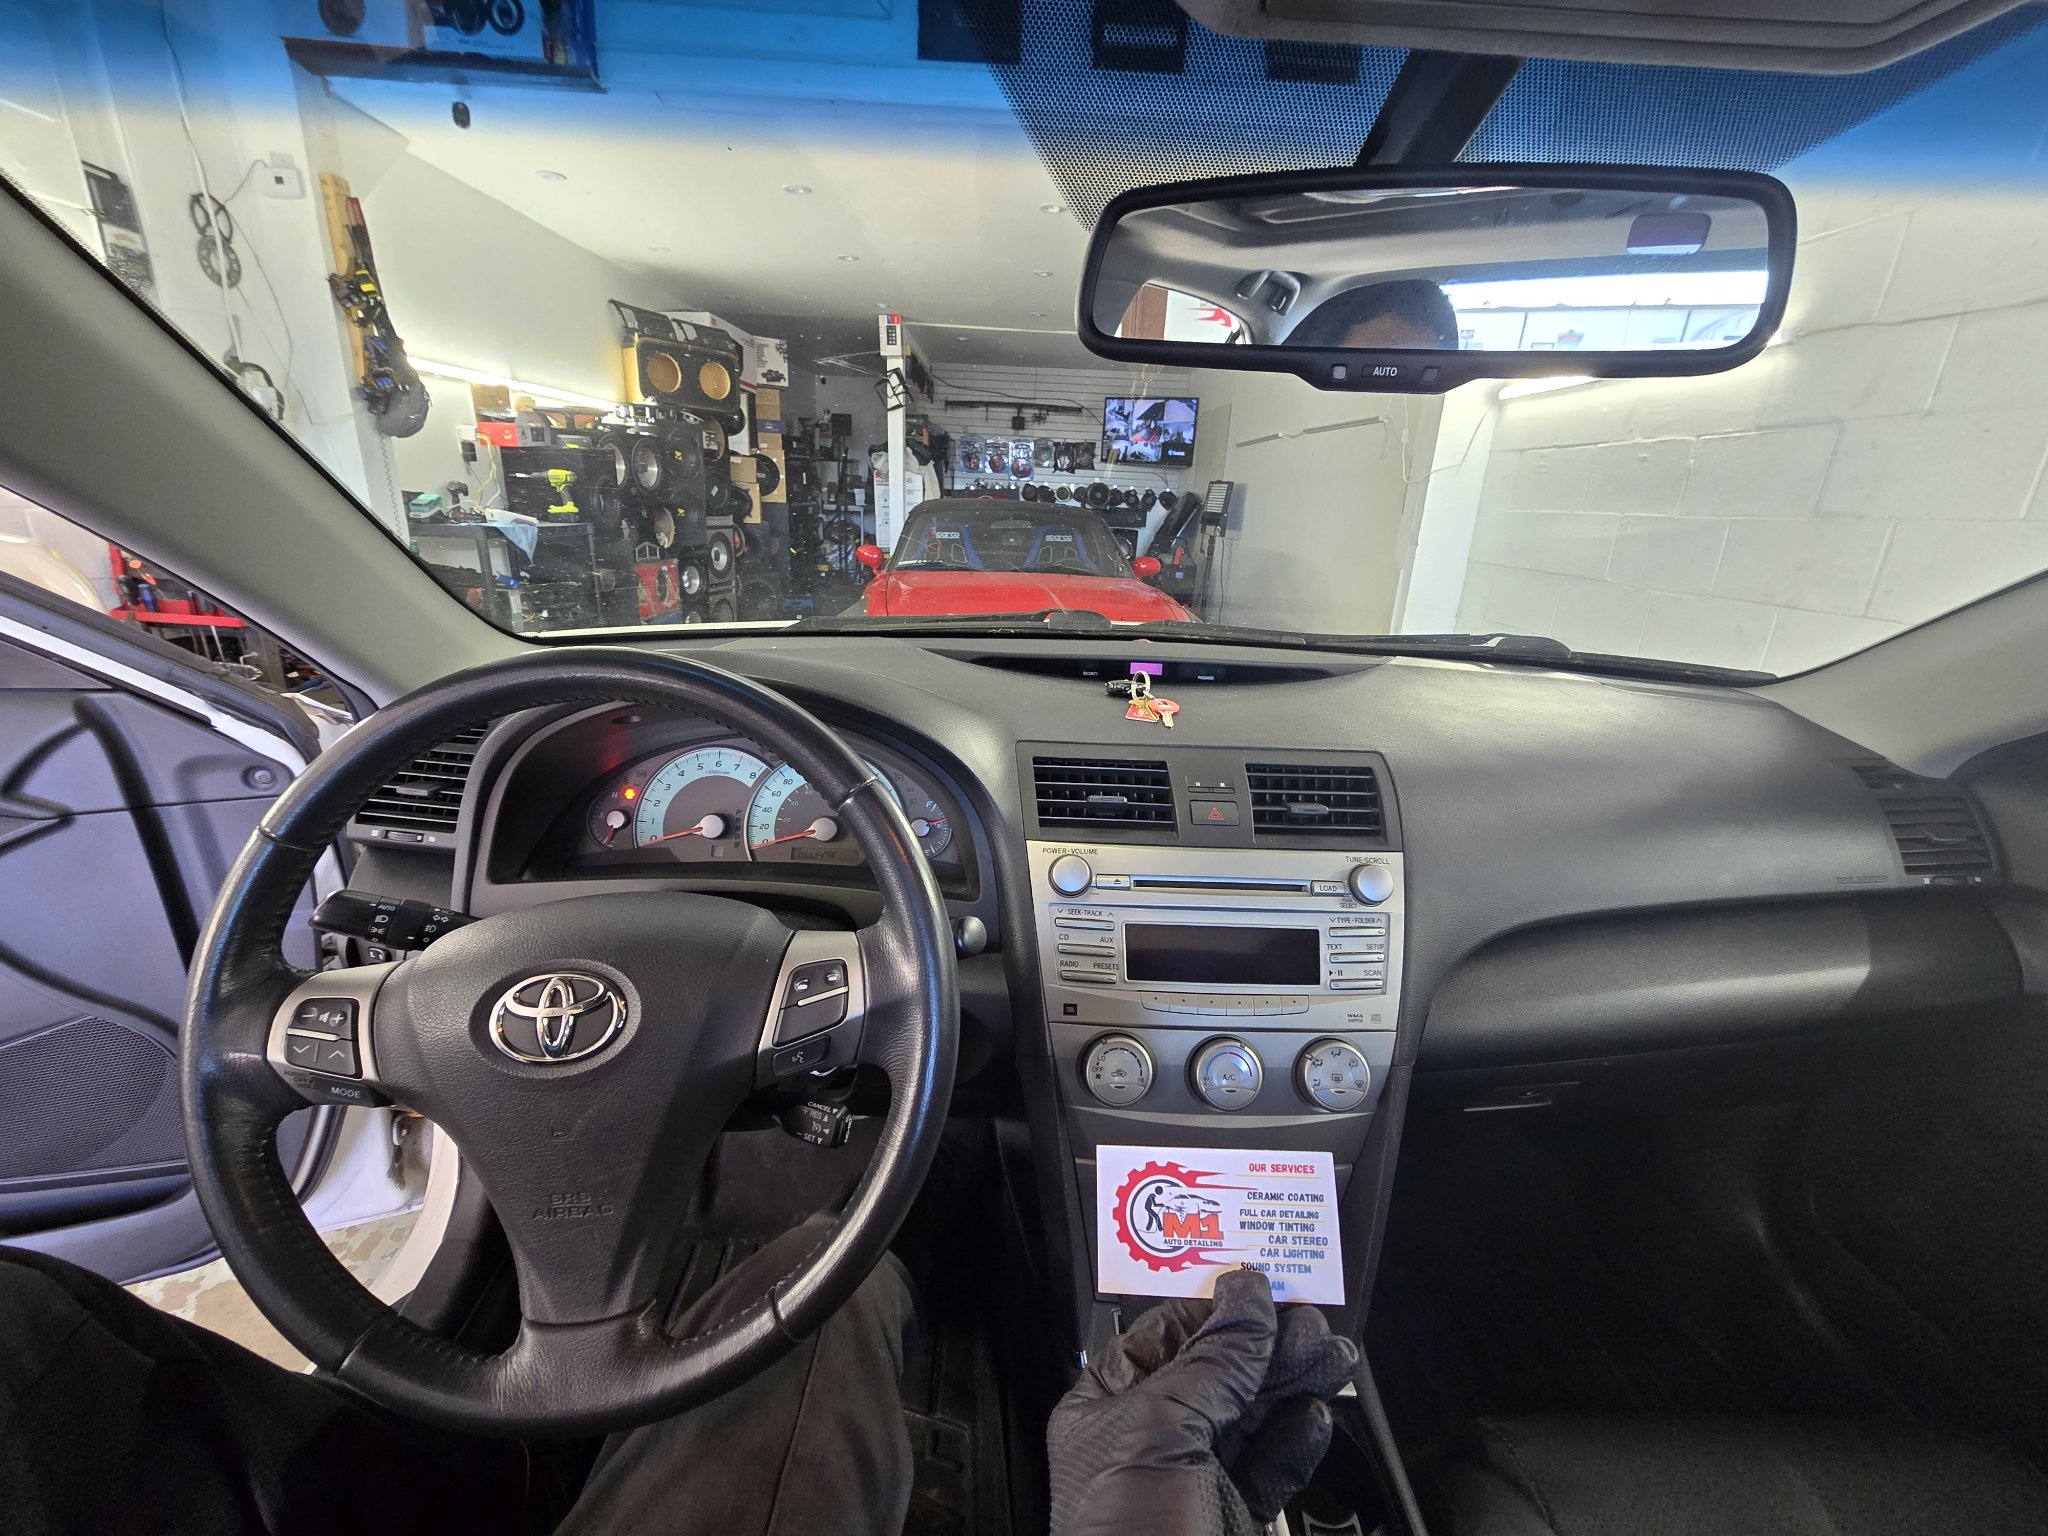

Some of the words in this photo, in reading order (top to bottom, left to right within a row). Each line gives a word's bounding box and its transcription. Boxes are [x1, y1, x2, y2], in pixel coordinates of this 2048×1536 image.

[1372, 366, 1398, 377] AUTO
[697, 762, 704, 771] 5
[715, 760, 722, 768] 6
[733, 763, 741, 771] 7
[749, 771, 757, 780] 8
[664, 783, 672, 791] 3
[653, 799, 661, 807] 2
[1319, 884, 1338, 892] LOAD
[1058, 933, 1070, 941] CD
[1099, 936, 1114, 944] AUX
[1059, 960, 1079, 968] RADIO
[1093, 962, 1120, 971] PRESETS
[1222, 1073, 1236, 1081] A/C
[330, 1086, 361, 1099] MODE
[807, 1101, 831, 1113] CANCEL
[1248, 1163, 1267, 1173] OUR
[1270, 1163, 1315, 1174] SERVICES
[1247, 1191, 1285, 1201] CERAMIC
[1287, 1193, 1325, 1203] COATING
[1239, 1208, 1258, 1217] FULL
[1260, 1209, 1277, 1218] CAR
[1279, 1210, 1319, 1220] DETAILING
[1162, 1212, 1225, 1241] M1
[1239, 1220, 1275, 1231] WINDOW
[1279, 1222, 1315, 1232] TINTING
[1163, 1238, 1182, 1246] AUTO
[1183, 1239, 1224, 1247] DETAILING
[1268, 1234, 1288, 1245] CAR
[1291, 1236, 1329, 1246] STEREO
[1259, 1247, 1280, 1258] CAR
[1283, 1248, 1325, 1259] LIGHTING
[1240, 1261, 1271, 1272] SOUND
[1274, 1263, 1312, 1274] SYSTEM
[1271, 1280, 1286, 1291] AM
